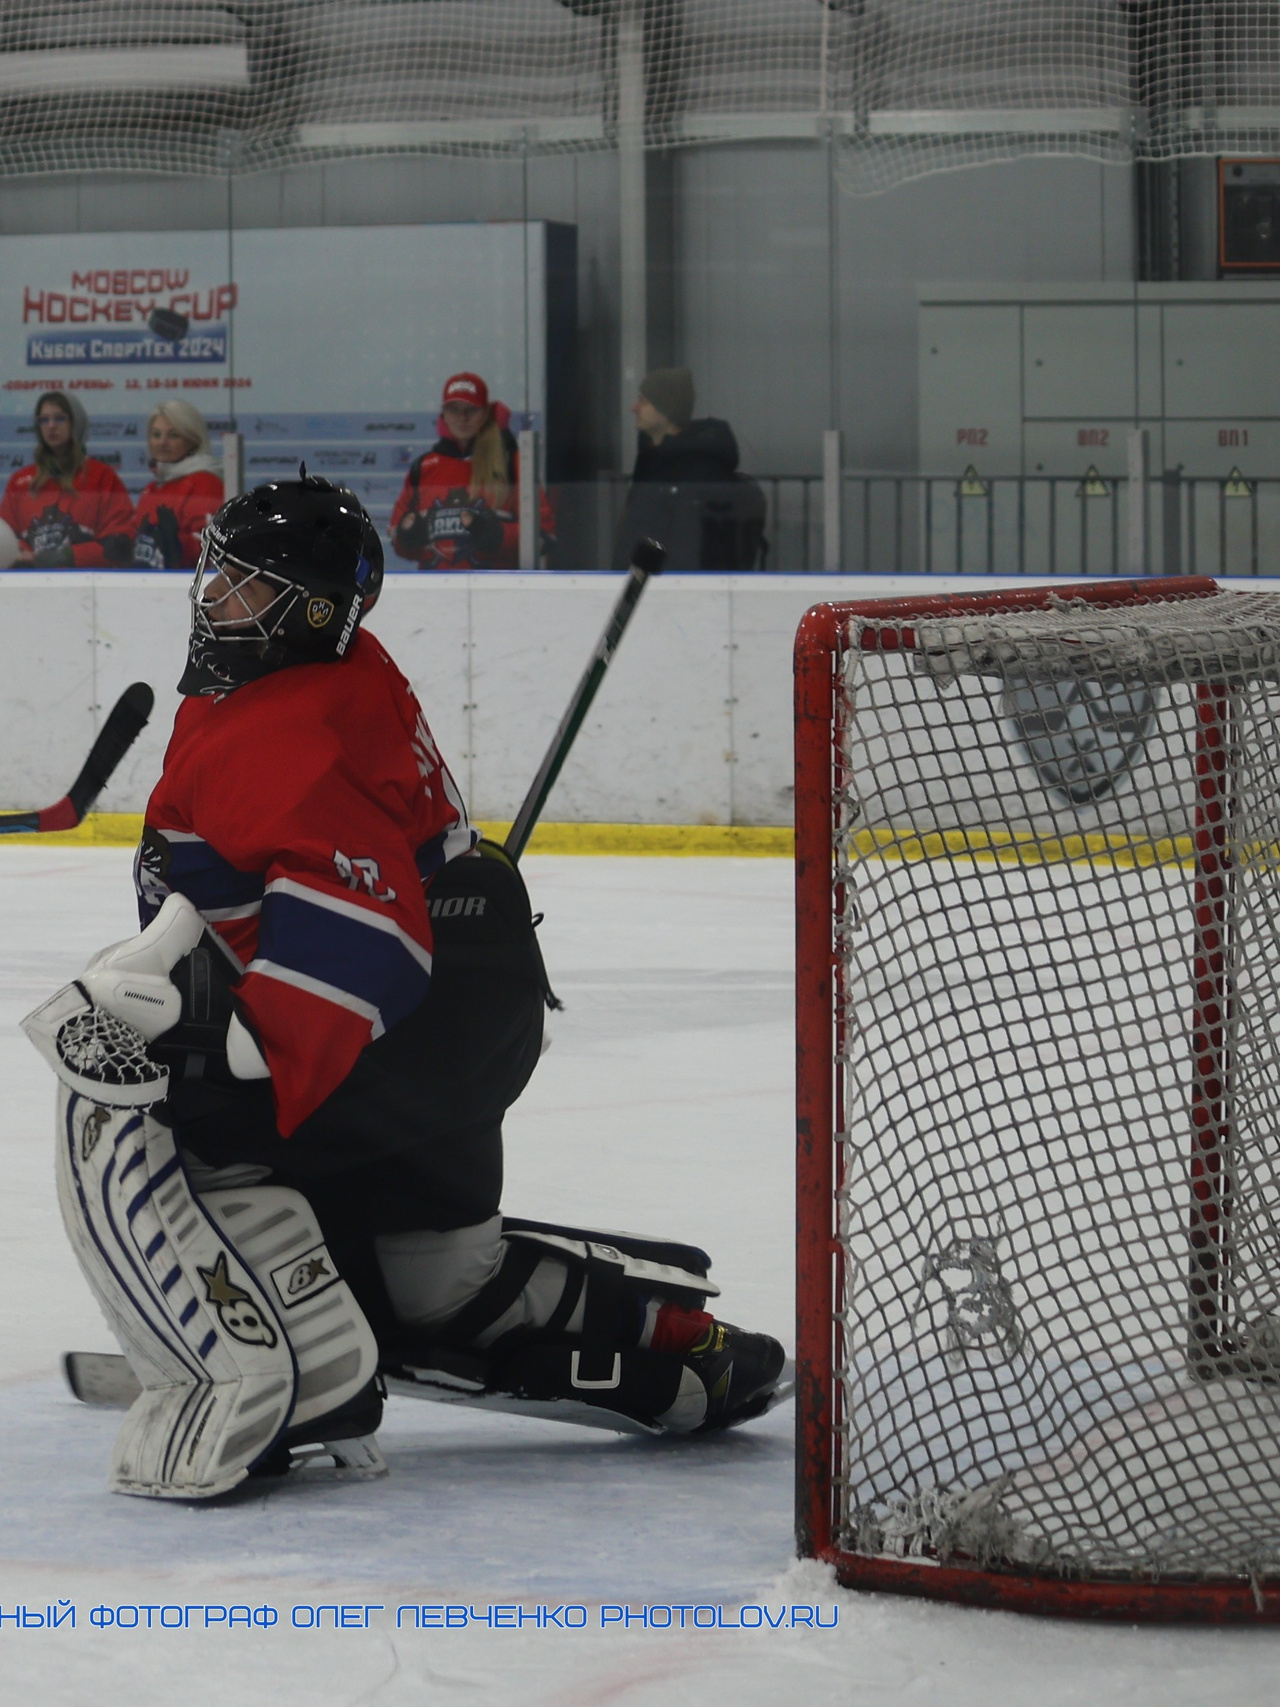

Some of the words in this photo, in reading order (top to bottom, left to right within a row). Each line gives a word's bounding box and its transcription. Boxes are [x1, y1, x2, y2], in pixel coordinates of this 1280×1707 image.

[72, 268, 189, 295] MOSCOW
[23, 286, 157, 324] HOCKEY
[169, 282, 238, 321] CUP
[178, 336, 225, 357] 2024
